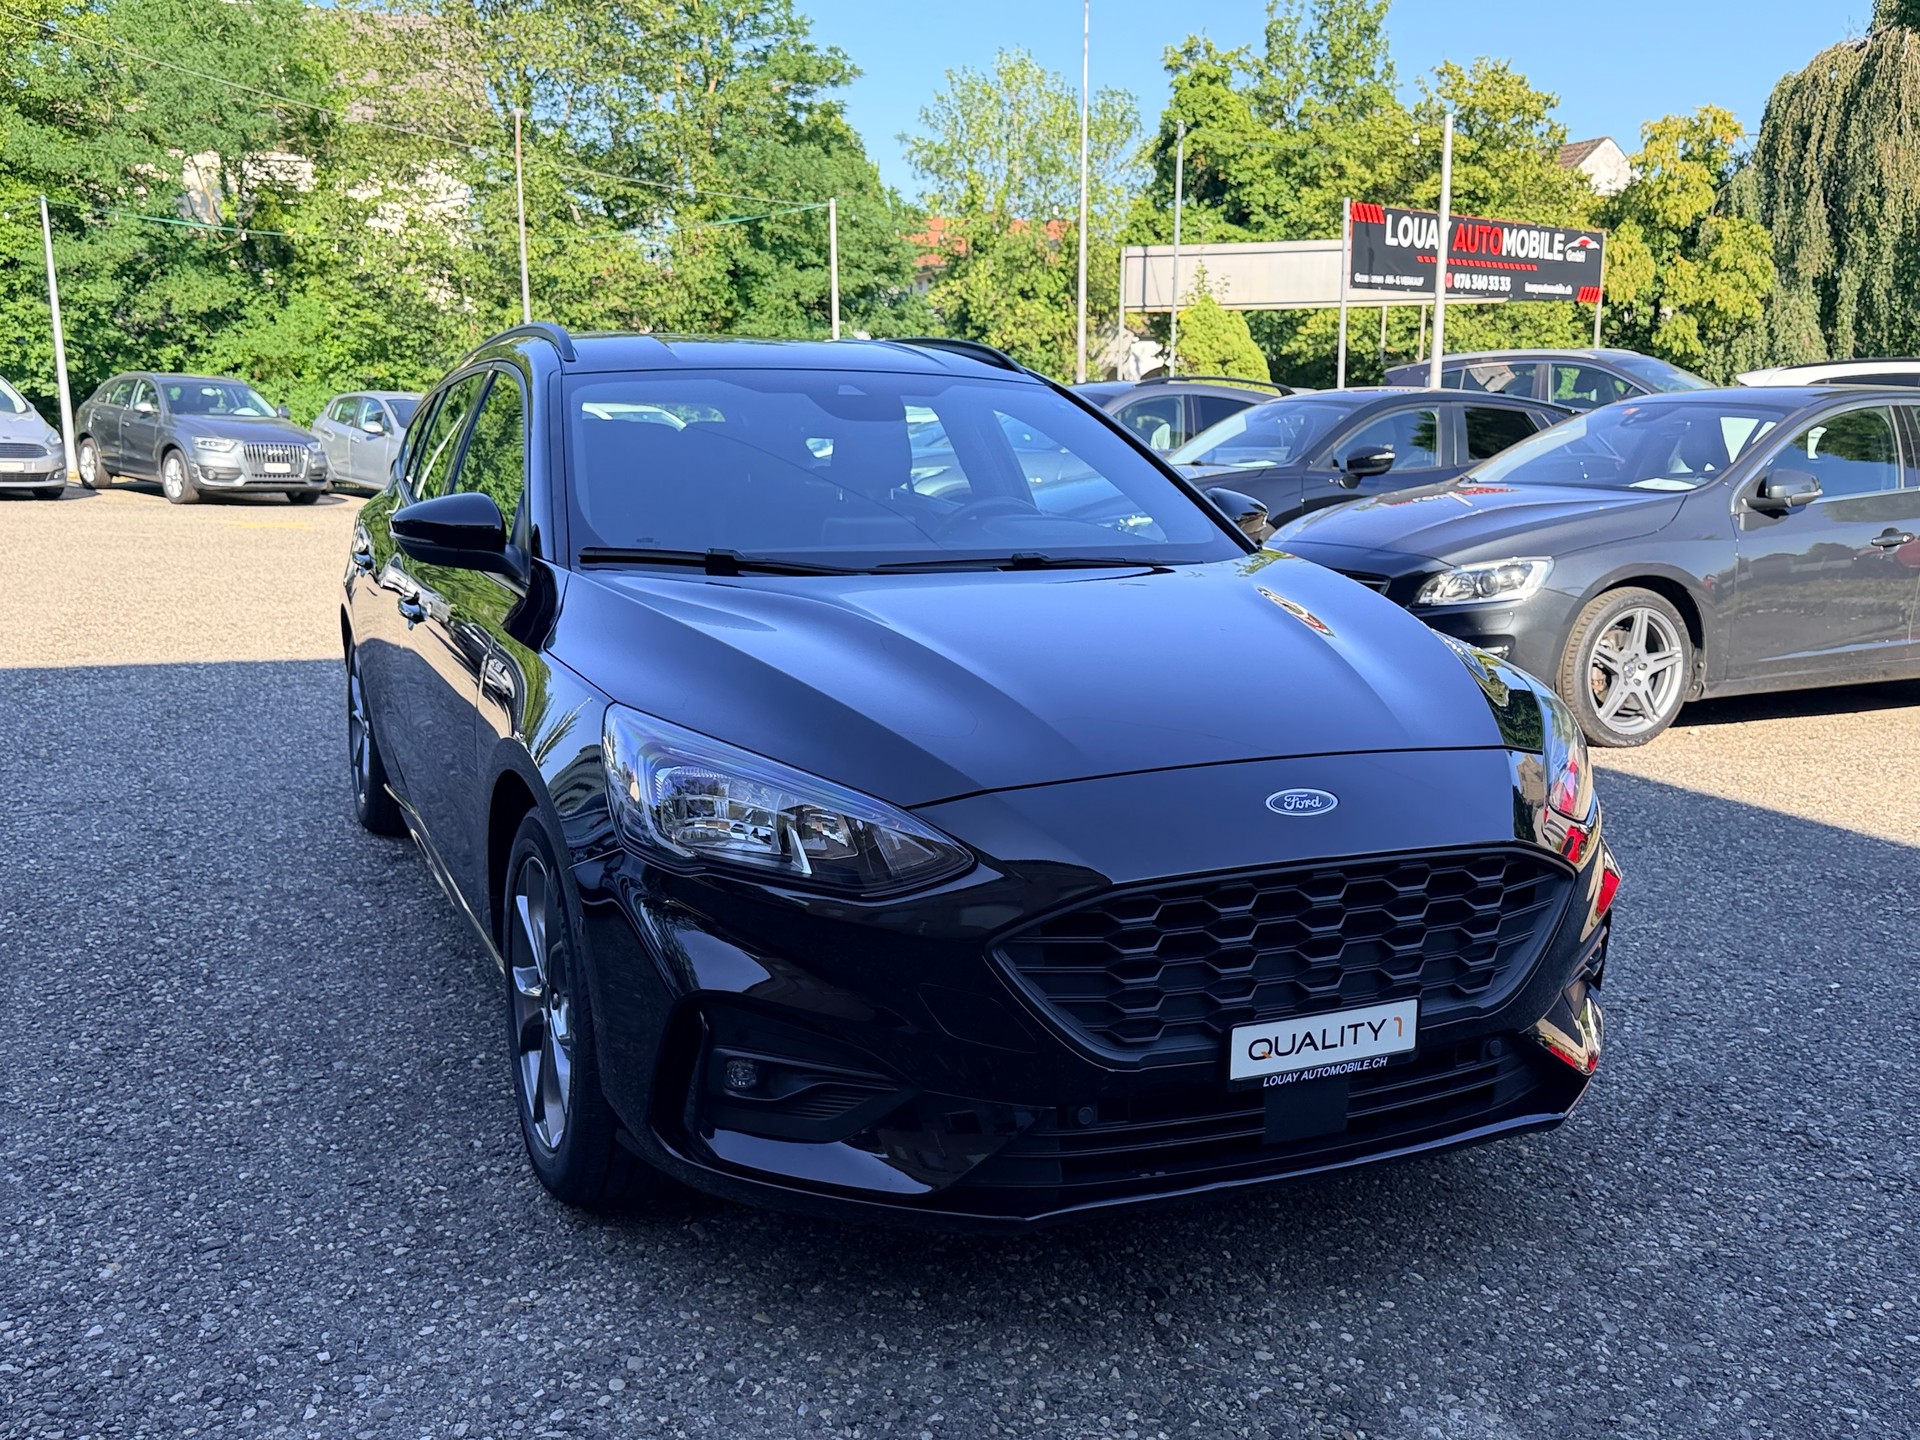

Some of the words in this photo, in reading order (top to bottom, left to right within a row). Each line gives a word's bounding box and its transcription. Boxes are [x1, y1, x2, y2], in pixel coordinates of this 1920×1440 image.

[1385, 214, 1452, 250] LOUA
[1452, 223, 1565, 261] AUTOMOBILE
[1454, 273, 1471, 289] 076
[1284, 794, 1322, 810] Ford
[1248, 1018, 1387, 1061] QUALITY
[1263, 1071, 1300, 1087] LOUAY
[1301, 1056, 1388, 1080] AUTOMOBILE.CH
